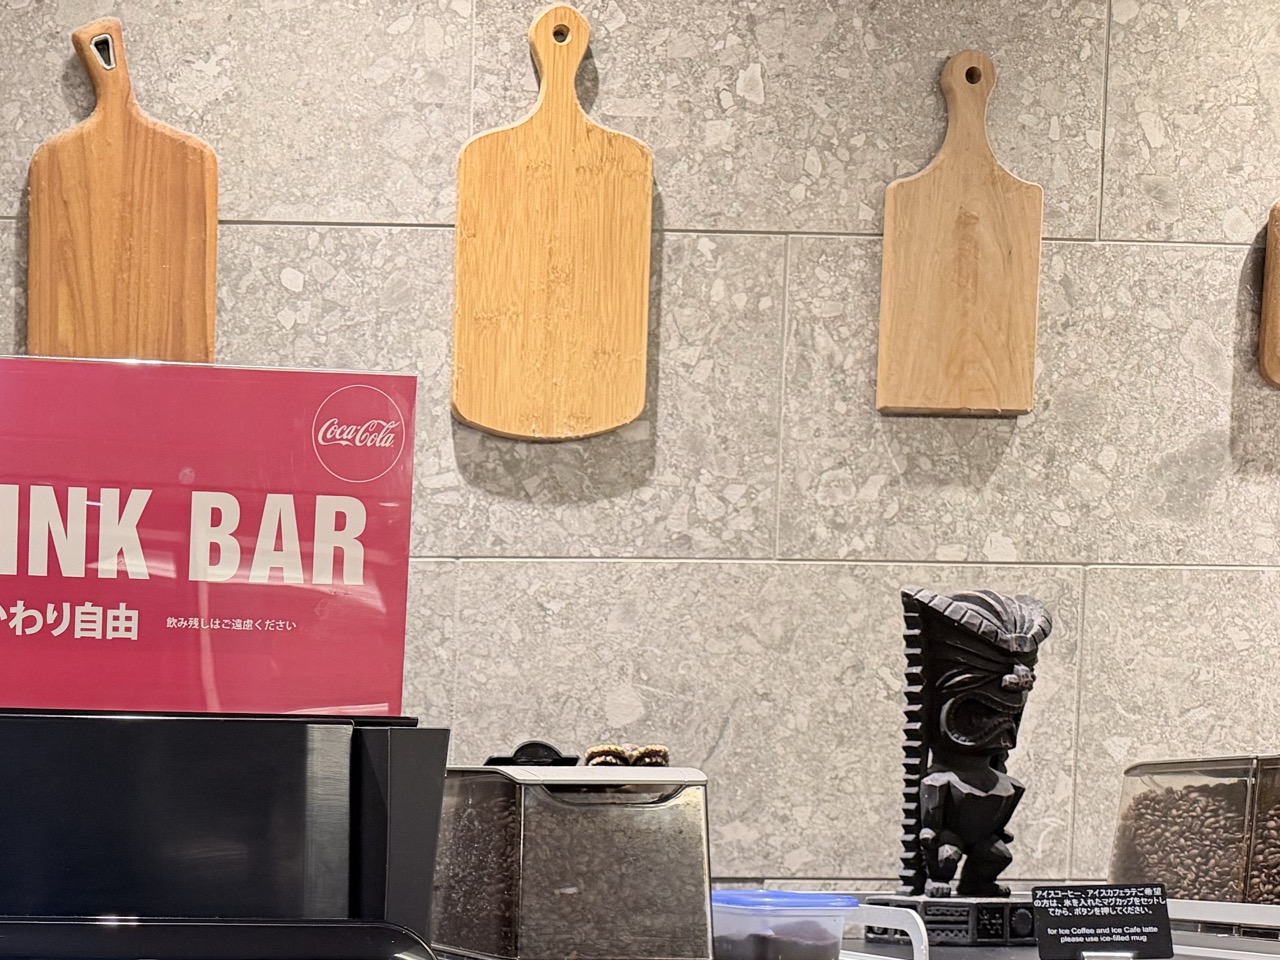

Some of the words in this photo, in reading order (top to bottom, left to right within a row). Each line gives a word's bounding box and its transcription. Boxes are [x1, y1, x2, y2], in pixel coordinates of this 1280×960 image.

[318, 418, 400, 447] Coca-Cola
[189, 490, 366, 586] BAR
[166, 616, 297, 632] 飲み残しはご遠慮ください
[1035, 887, 1162, 898] アイスコーヒー、アイスカフェラテご希望
[1033, 897, 1166, 907] の方は、氷を入れたマグカップをセットし
[1047, 907, 1153, 916] てから、ボタンを押してください。
